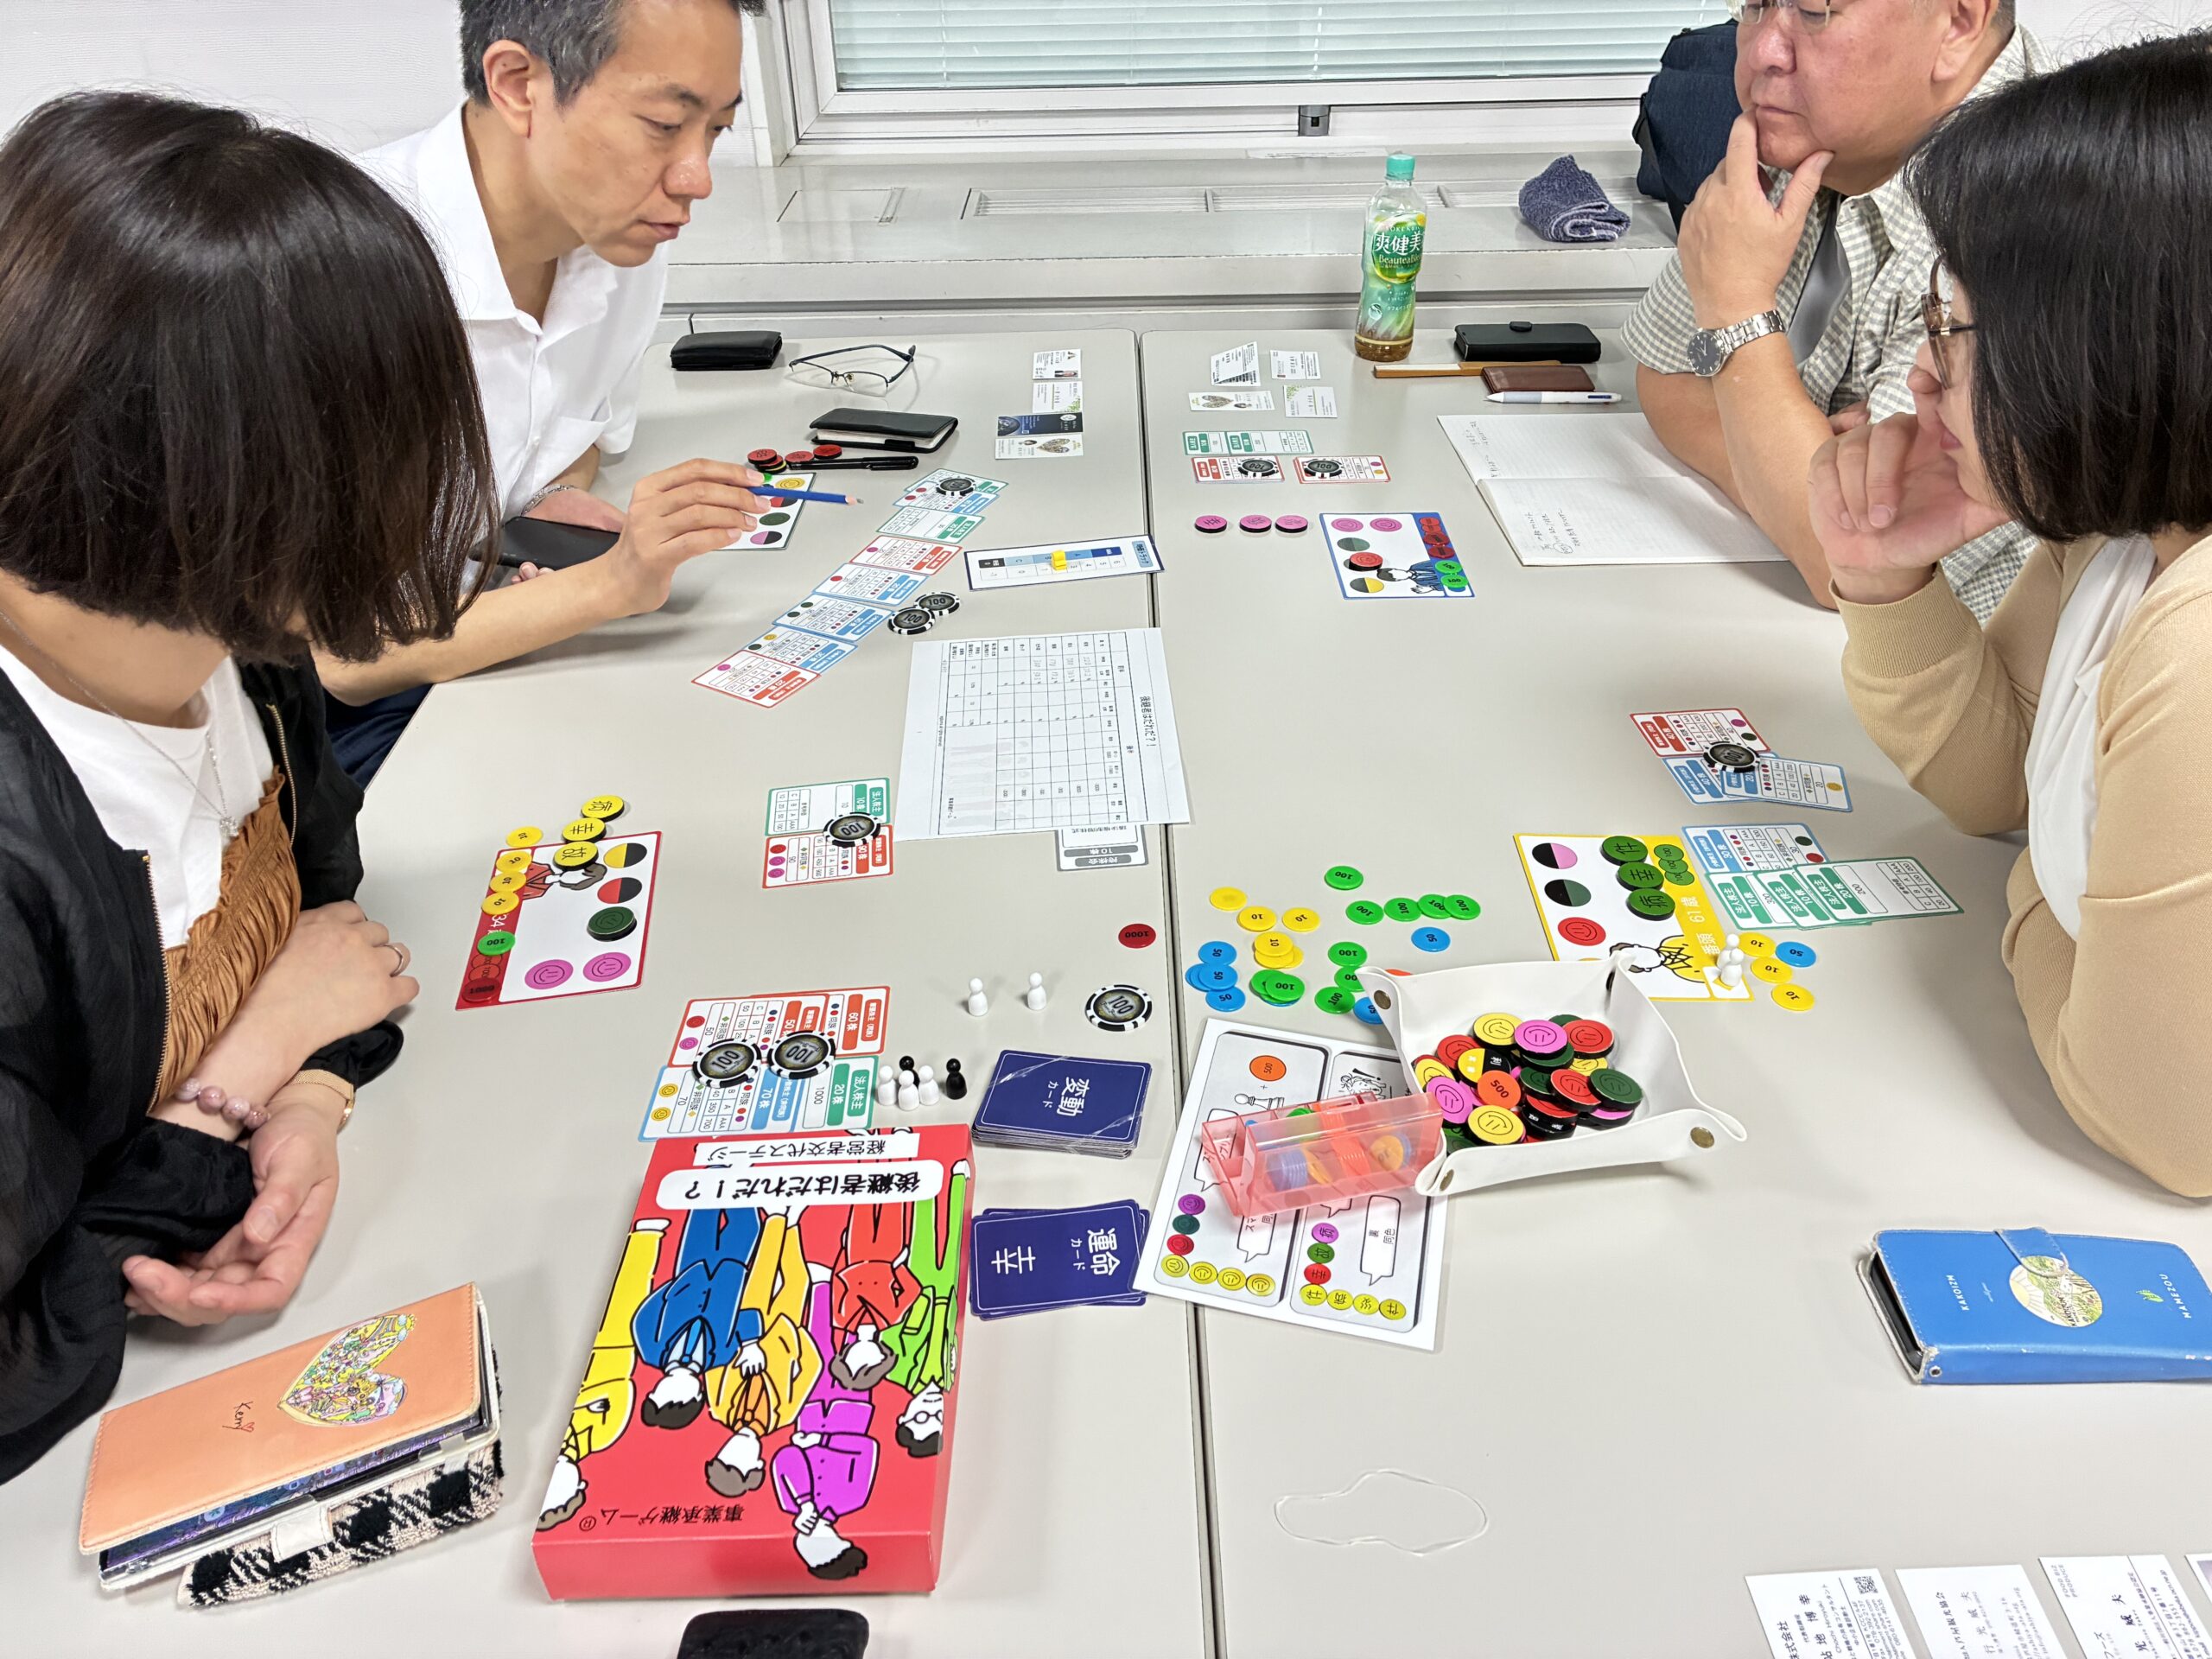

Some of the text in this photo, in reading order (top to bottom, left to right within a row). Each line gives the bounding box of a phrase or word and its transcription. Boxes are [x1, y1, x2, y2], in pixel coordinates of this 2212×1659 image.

[927, 597, 945, 606] 100
[902, 613, 922, 623] 100
[1726, 751, 1745, 762] 100
[842, 823, 866, 836] 100
[1753, 830, 1763, 838] 300
[1717, 842, 1733, 859] 30株
[1789, 846, 1800, 855] 30
[509, 856, 521, 865] 10
[1903, 862, 1915, 871] 200
[1629, 868, 1655, 881] 幸
[1890, 863, 1902, 874] AAA
[1913, 874, 1923, 884] 100
[1811, 878, 1840, 905] 法人株主
[1834, 882, 1853, 899] 20株
[1852, 883, 1866, 896] 200
[493, 898, 506, 906] 10
[1638, 895, 1668, 908] 病
[1724, 884, 1746, 914] 法人株主
[1743, 890, 1757, 907] 10株
[1763, 893, 1776, 905] 300
[1773, 886, 1802, 913] 法人株主
[1794, 889, 1814, 905] 10株
[1356, 906, 1374, 916] 100
[1397, 902, 1408, 914] 100
[1455, 899, 1469, 911] 100
[486, 938, 506, 947] 100
[1697, 933, 1720, 956] 番頭
[1212, 949, 1222, 957] 50
[1214, 971, 1223, 980] 50
[1328, 993, 1343, 1006] 100
[1785, 991, 1799, 1001] 10
[1109, 995, 1135, 1014] 100
[736, 1019, 745, 1028] 100
[847, 1013, 859, 1030] 60株
[704, 1027, 715, 1036] 50
[763, 1023, 774, 1035] 同族
[712, 1050, 740, 1071] 100
[785, 1045, 814, 1063] 100
[1264, 1063, 1273, 1074] 500
[832, 1084, 845, 1104] 20株
[850, 1076, 867, 1110] 法人株主
[1042, 1081, 1058, 1109] カード
[1491, 1079, 1510, 1098] 500
[677, 1096, 688, 1106] 70
[690, 1091, 703, 1111] 非同族
[739, 1092, 751, 1105] 同族
[758, 1087, 773, 1109] 70株
[815, 1086, 825, 1105] 1000
[1056, 1076, 1090, 1116] 変動
[703, 1102, 715, 1130] 350 700
[719, 1117, 728, 1129] AAA
[707, 1138, 887, 1162] 経営者交代ステージ
[683, 1168, 922, 1201] 後継者はだれだ！？
[1071, 1238, 1086, 1271] カード
[1087, 1228, 1121, 1276] 運命
[2159, 1273, 2191, 1319] MAMEZOU
